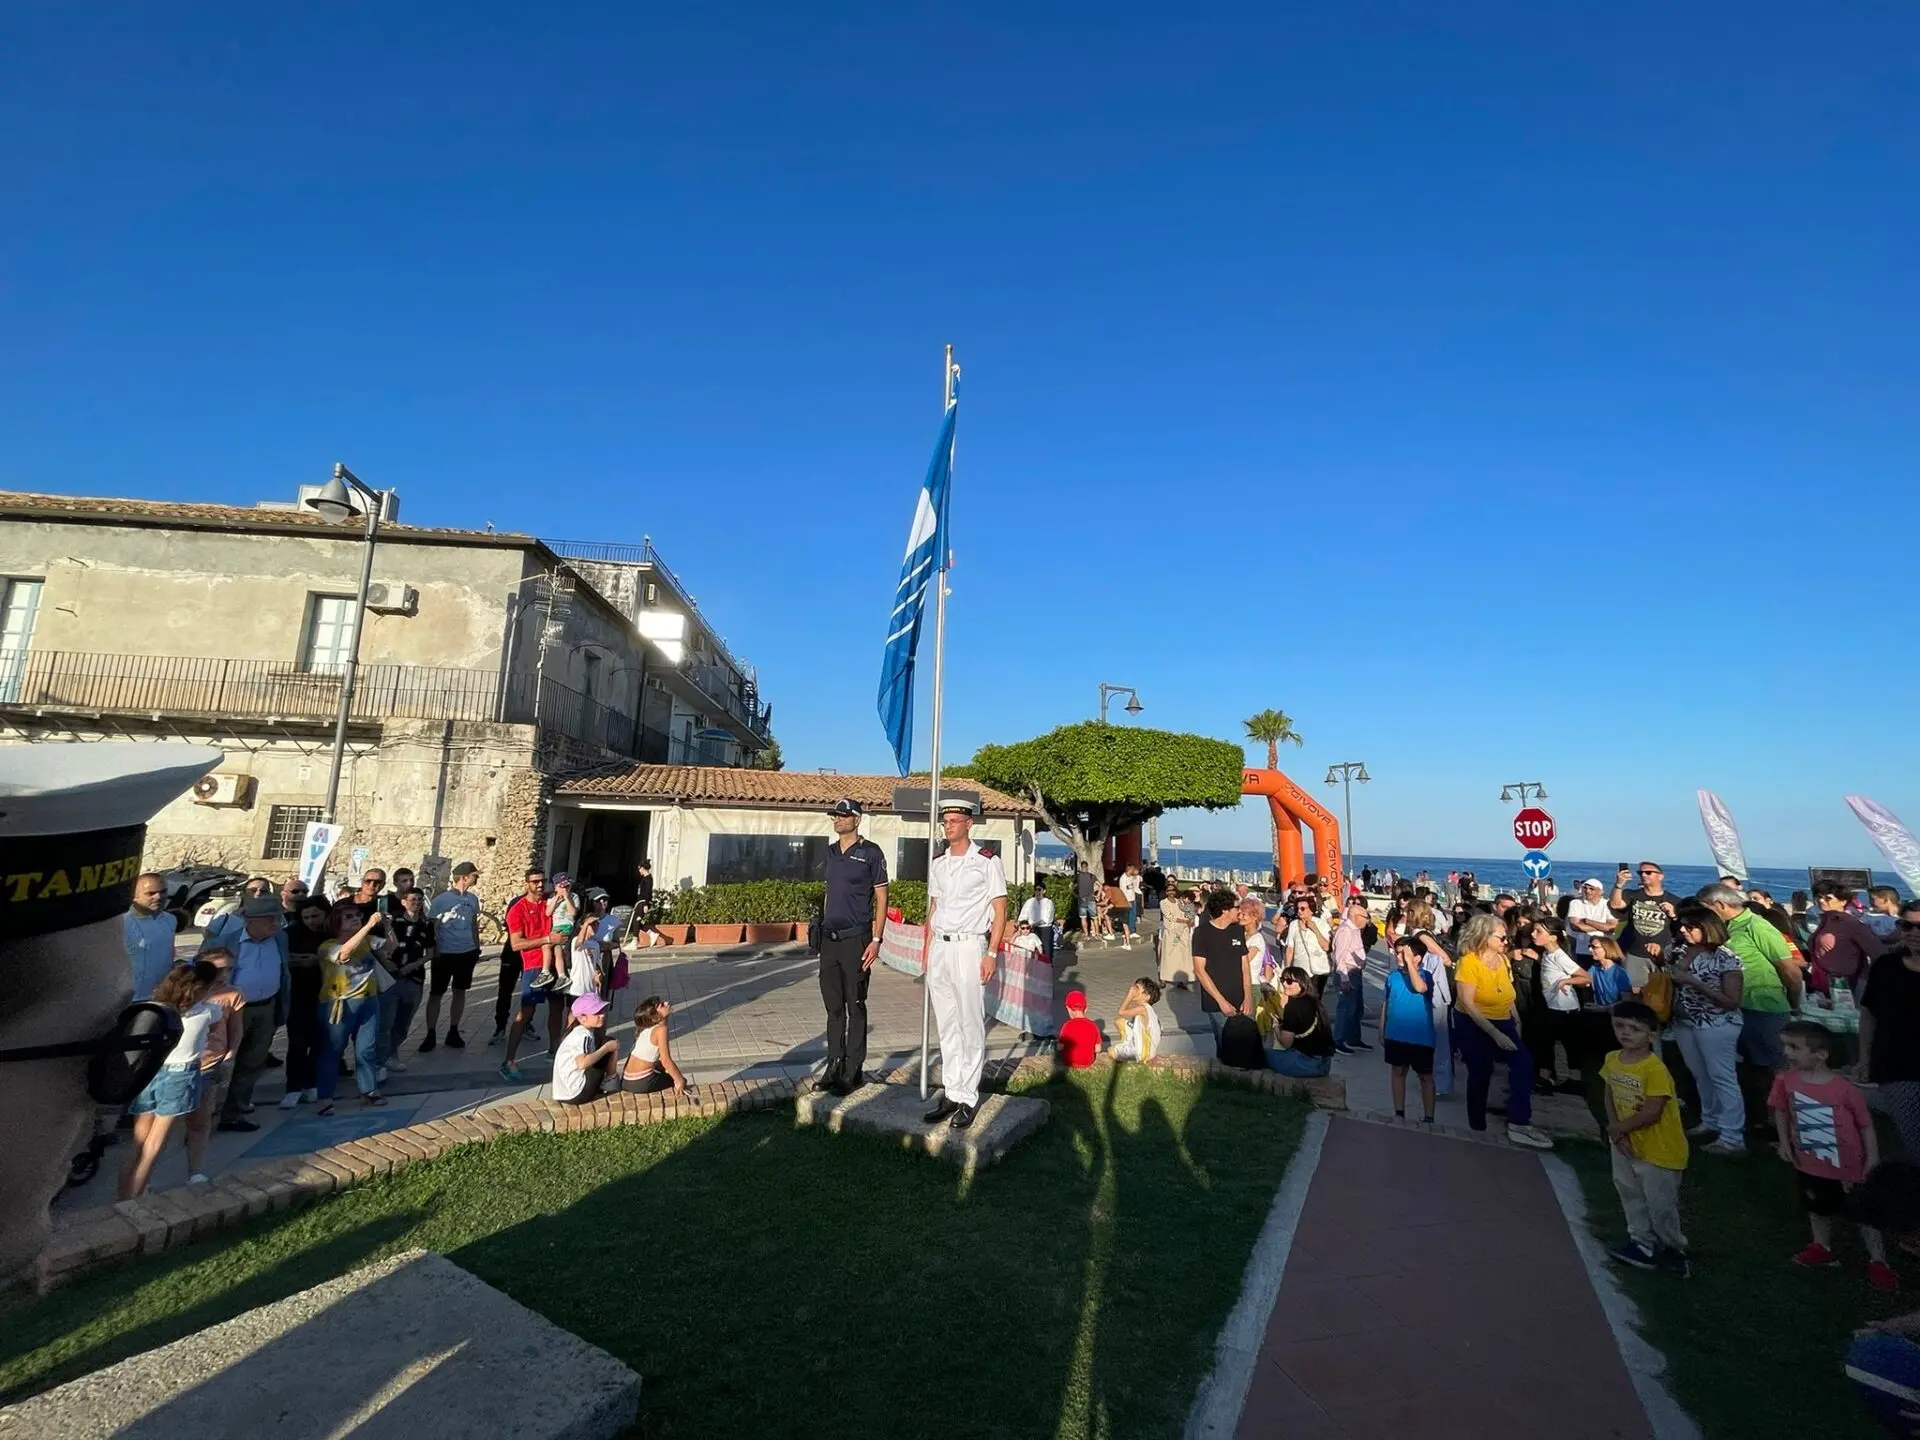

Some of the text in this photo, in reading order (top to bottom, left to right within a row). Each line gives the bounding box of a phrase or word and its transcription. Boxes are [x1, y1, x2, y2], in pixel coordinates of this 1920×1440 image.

[1290, 788, 1331, 825] GIVOVA
[1515, 820, 1551, 837] STOP
[0, 856, 140, 902] TANER
[1328, 849, 1340, 897] GIVOVA
